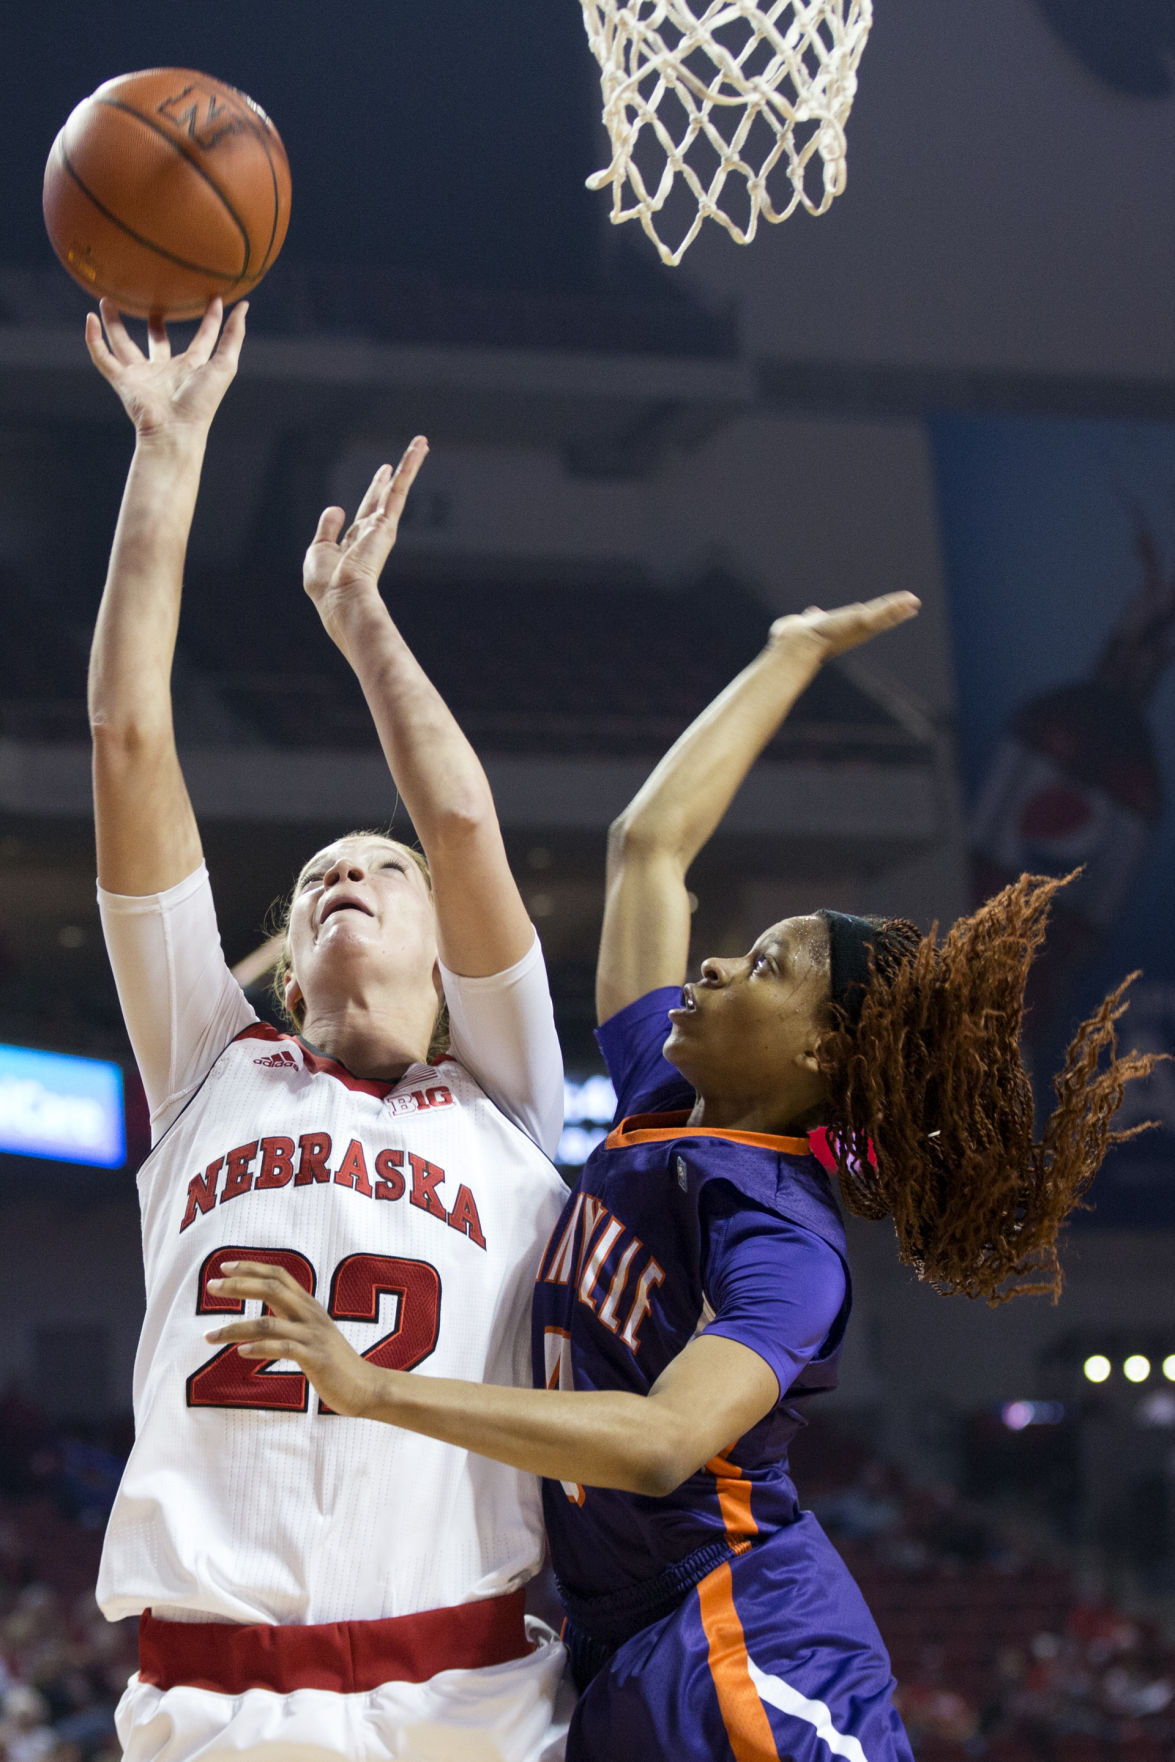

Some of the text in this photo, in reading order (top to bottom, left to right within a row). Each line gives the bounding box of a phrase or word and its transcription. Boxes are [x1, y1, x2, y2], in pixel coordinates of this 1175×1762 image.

[253, 1058, 299, 1072] adidas
[179, 1132, 487, 1252] NEBRASKA
[186, 1245, 442, 1415] 22
